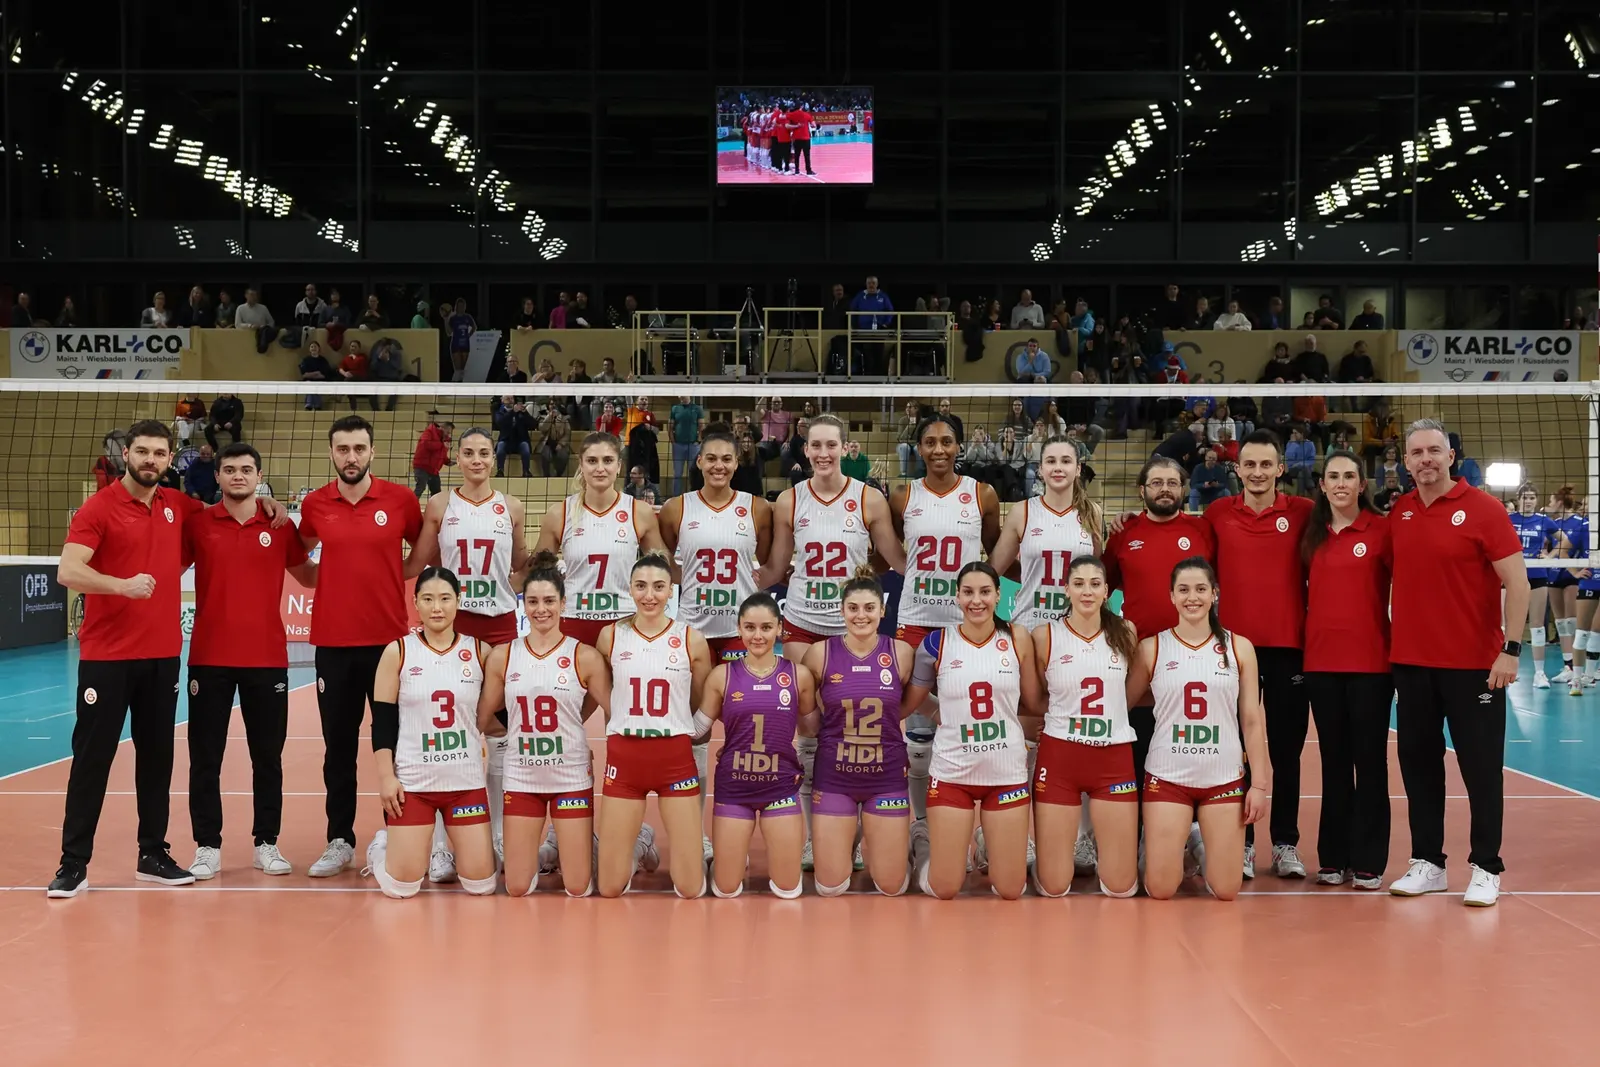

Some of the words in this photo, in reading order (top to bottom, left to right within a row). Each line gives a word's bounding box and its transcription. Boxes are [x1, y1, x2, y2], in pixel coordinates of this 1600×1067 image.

[56, 355, 79, 363] Mainz
[86, 355, 127, 363] Wiesbaden
[134, 355, 180, 363] Rüsselsheim
[1444, 357, 1466, 365] Mainz
[1474, 357, 1515, 365] Wiesbaden
[456, 539, 496, 576] 17
[805, 541, 847, 577] 22
[916, 535, 962, 572] 20
[588, 554, 609, 589] 7
[696, 548, 739, 584] 33
[1041, 550, 1072, 586] 11
[25, 573, 48, 598] OFB
[460, 580, 497, 599] HDI
[914, 577, 957, 596] HDI
[460, 600, 497, 608] İGORTA
[576, 593, 619, 610] HDI
[696, 588, 737, 607] HDI
[805, 601, 840, 610] SİGORT
[1034, 591, 1070, 610] HD
[1033, 611, 1064, 620] SİGO
[286, 624, 311, 635] Nas
[629, 677, 670, 718] 10
[968, 681, 994, 720] 8
[1080, 676, 1104, 716] 2
[1183, 681, 1208, 720] 6
[431, 689, 455, 729] 3
[516, 695, 559, 733] 18
[841, 697, 883, 736] 12
[750, 713, 766, 753] 1
[960, 720, 1007, 744] HDI
[1068, 717, 1112, 738] HDI
[1172, 724, 1220, 744] HDI
[422, 730, 467, 753] HDI
[518, 735, 564, 756] HDI
[732, 751, 779, 773] HDI
[836, 742, 884, 764] HDI
[605, 764, 617, 780] 10
[1039, 767, 1047, 782] 2
[673, 778, 698, 791] aksa
[931, 776, 939, 789] 8
[1114, 781, 1136, 793] aksa
[561, 799, 586, 807] aksa
[771, 796, 794, 808] ksa
[880, 798, 907, 807] aksa
[1002, 788, 1028, 801] aksa
[456, 805, 484, 815] aksa
